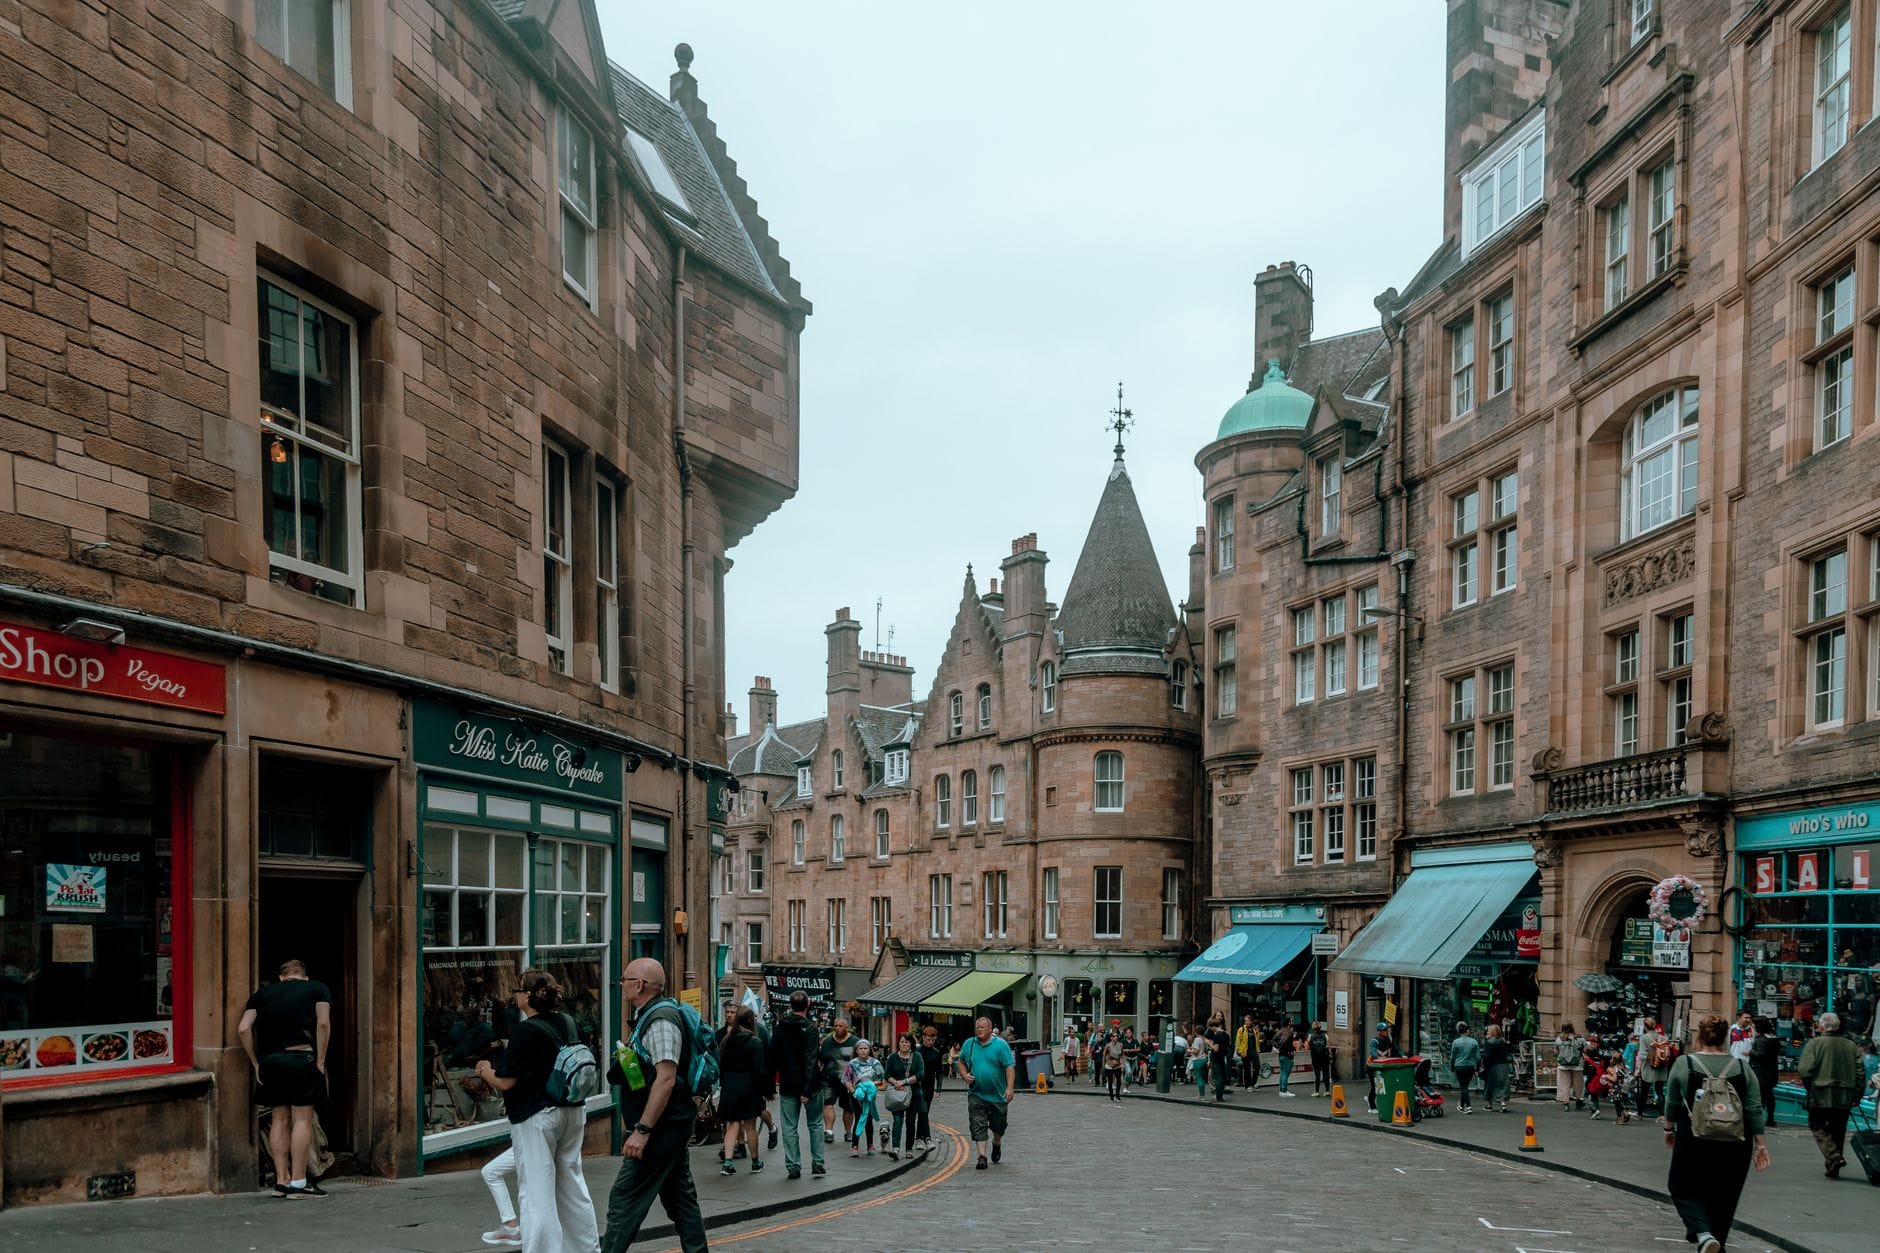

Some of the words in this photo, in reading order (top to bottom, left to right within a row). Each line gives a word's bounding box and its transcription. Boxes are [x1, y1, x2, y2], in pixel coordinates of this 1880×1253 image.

[0, 628, 104, 688] Shop
[126, 659, 187, 698] Vegan
[449, 720, 497, 761] Miss
[500, 733, 549, 772] Katie
[552, 743, 604, 788] Cupcake
[1789, 815, 1831, 835] who's
[1834, 810, 1868, 829] who
[57, 892, 98, 902] KRUSH
[920, 954, 929, 965] La
[930, 955, 957, 967] Locanda
[1459, 965, 1481, 974] GIFTS
[765, 975, 779, 987] WE
[786, 976, 831, 990] SCOTLAND
[1336, 1004, 1347, 1015] 65
